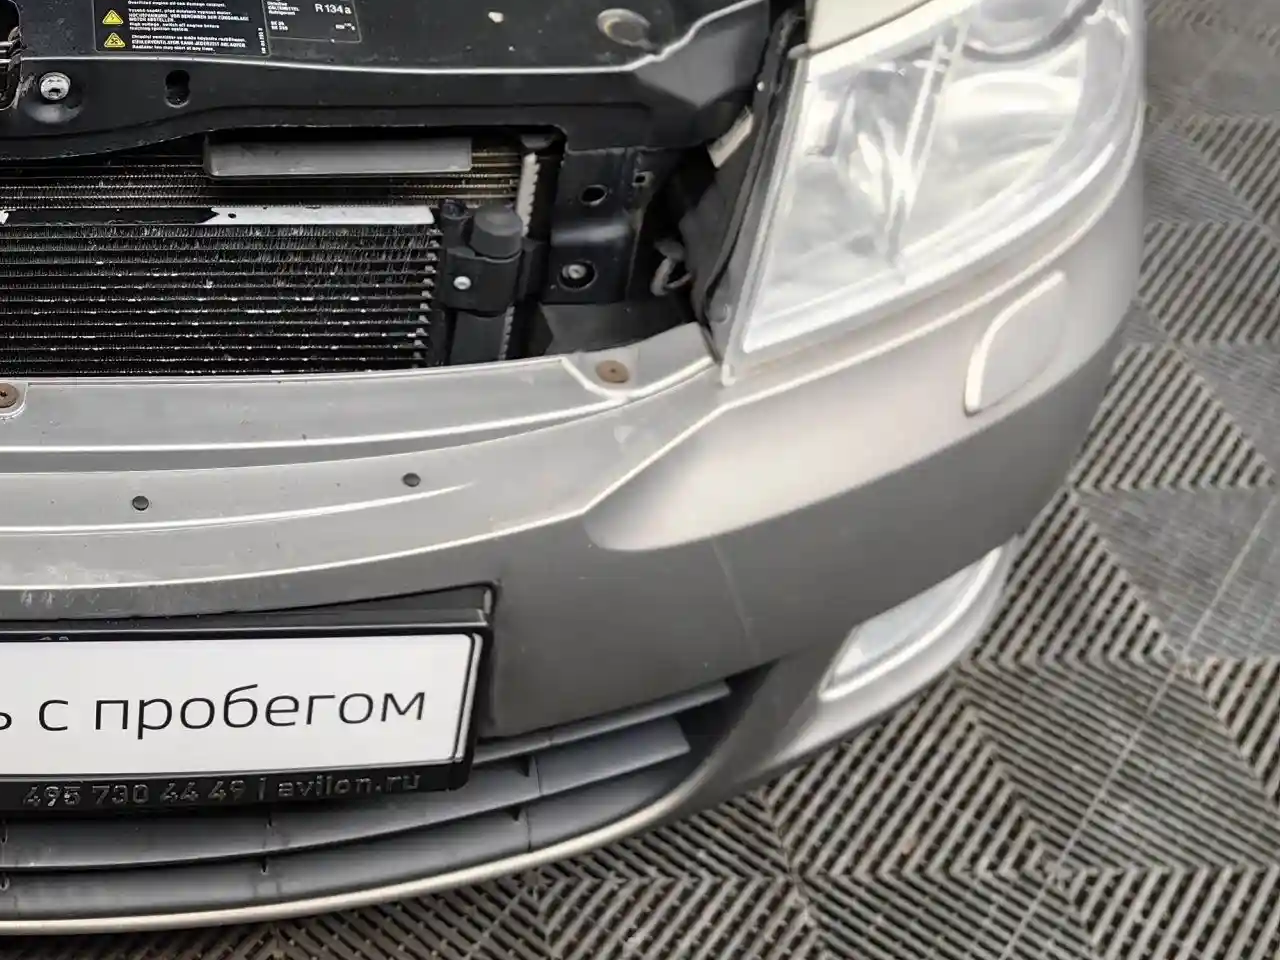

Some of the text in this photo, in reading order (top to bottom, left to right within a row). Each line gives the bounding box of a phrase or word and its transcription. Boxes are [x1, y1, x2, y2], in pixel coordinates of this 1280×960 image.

[38, 699, 69, 732] с
[95, 683, 425, 740] пробегом
[22, 785, 81, 807] 495
[92, 784, 150, 805] 730
[278, 773, 421, 797] avilon.ru
